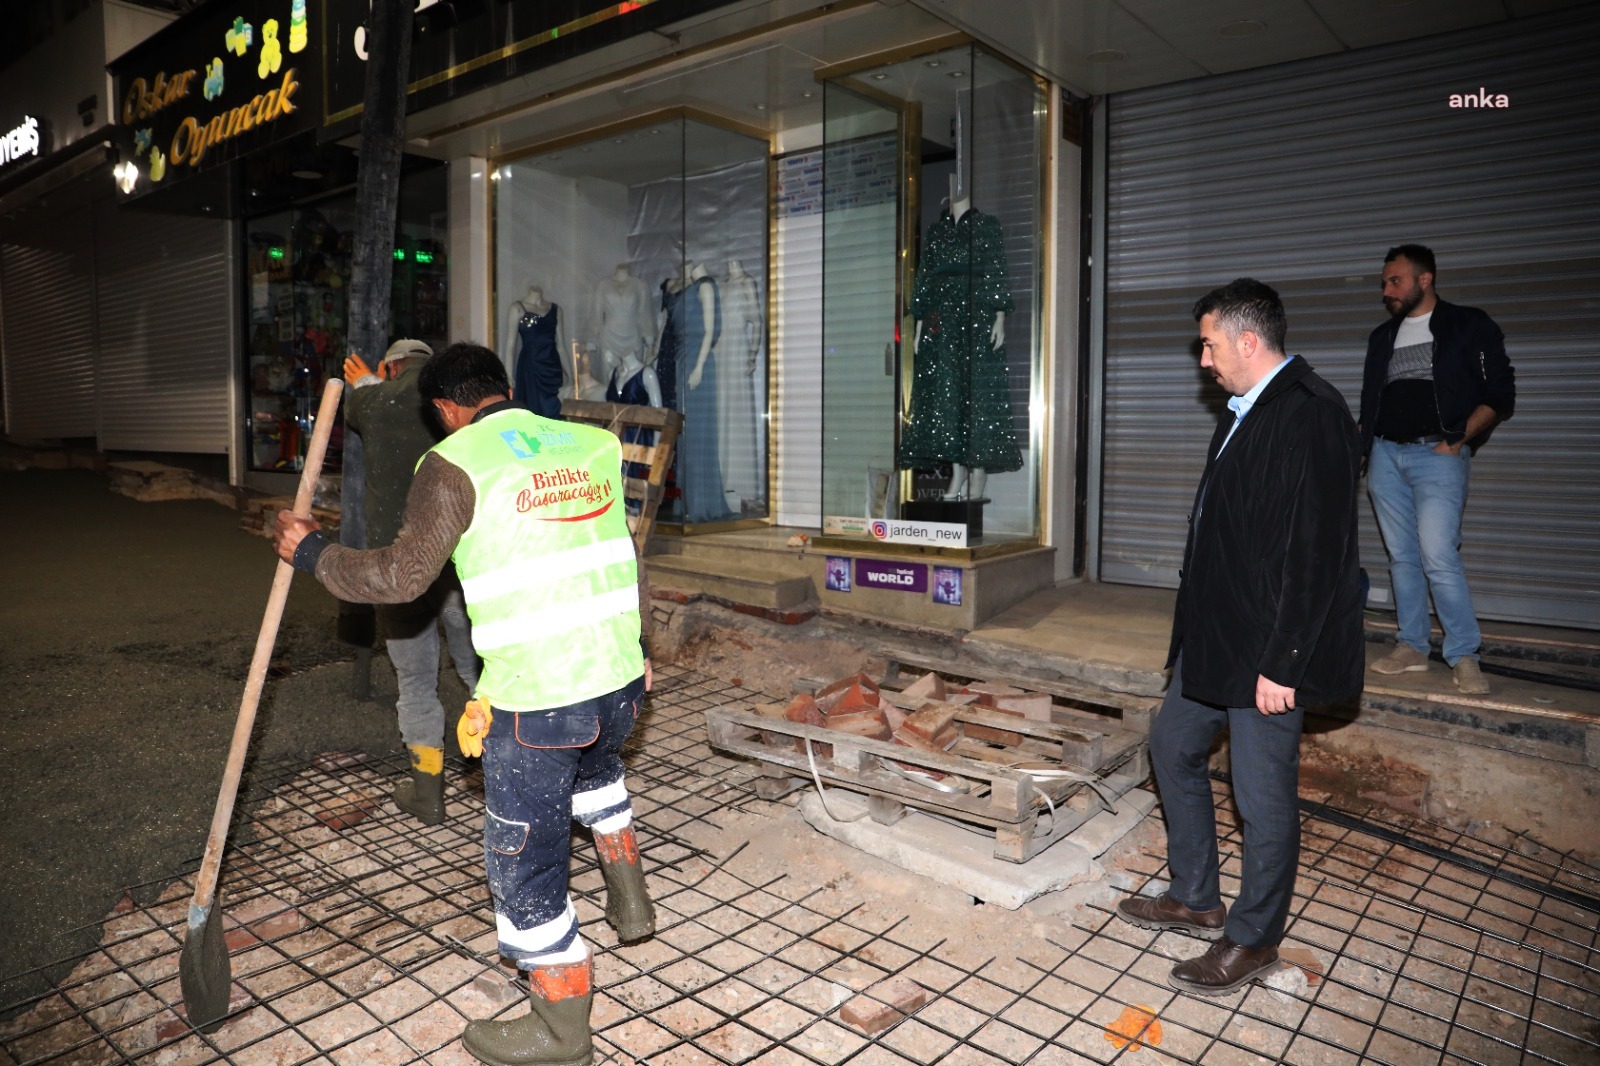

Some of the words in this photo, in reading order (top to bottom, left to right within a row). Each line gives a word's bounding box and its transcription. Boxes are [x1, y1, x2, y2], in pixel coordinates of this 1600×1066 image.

[123, 69, 196, 125] Oskar
[170, 67, 299, 167] Oyuncak
[531, 467, 591, 490] Birlikte
[889, 524, 962, 542] jarden_new
[867, 571, 915, 585] WORLD
